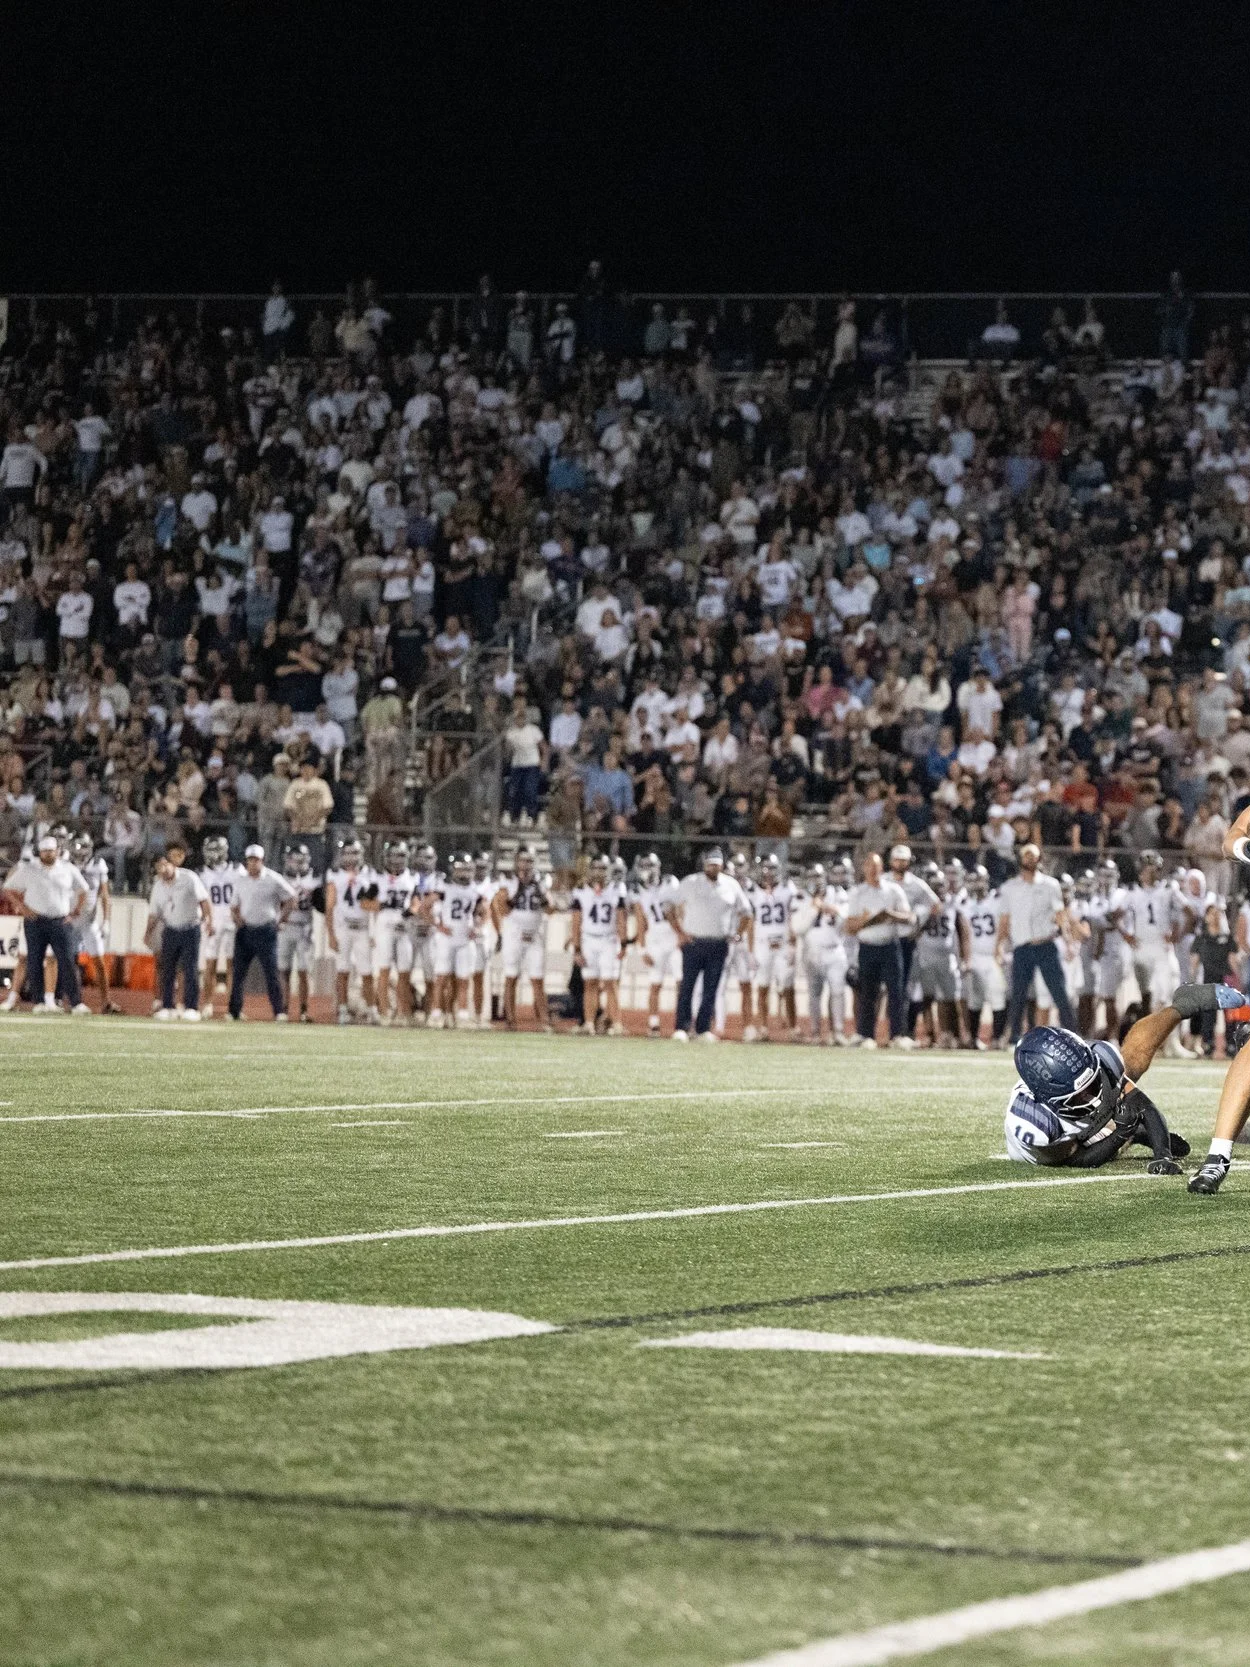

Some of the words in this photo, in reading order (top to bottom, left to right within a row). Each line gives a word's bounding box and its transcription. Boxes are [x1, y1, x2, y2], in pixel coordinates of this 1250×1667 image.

[210, 883, 233, 904] 80
[589, 903, 612, 923] 43
[761, 902, 785, 924] 23
[970, 913, 995, 937] 53
